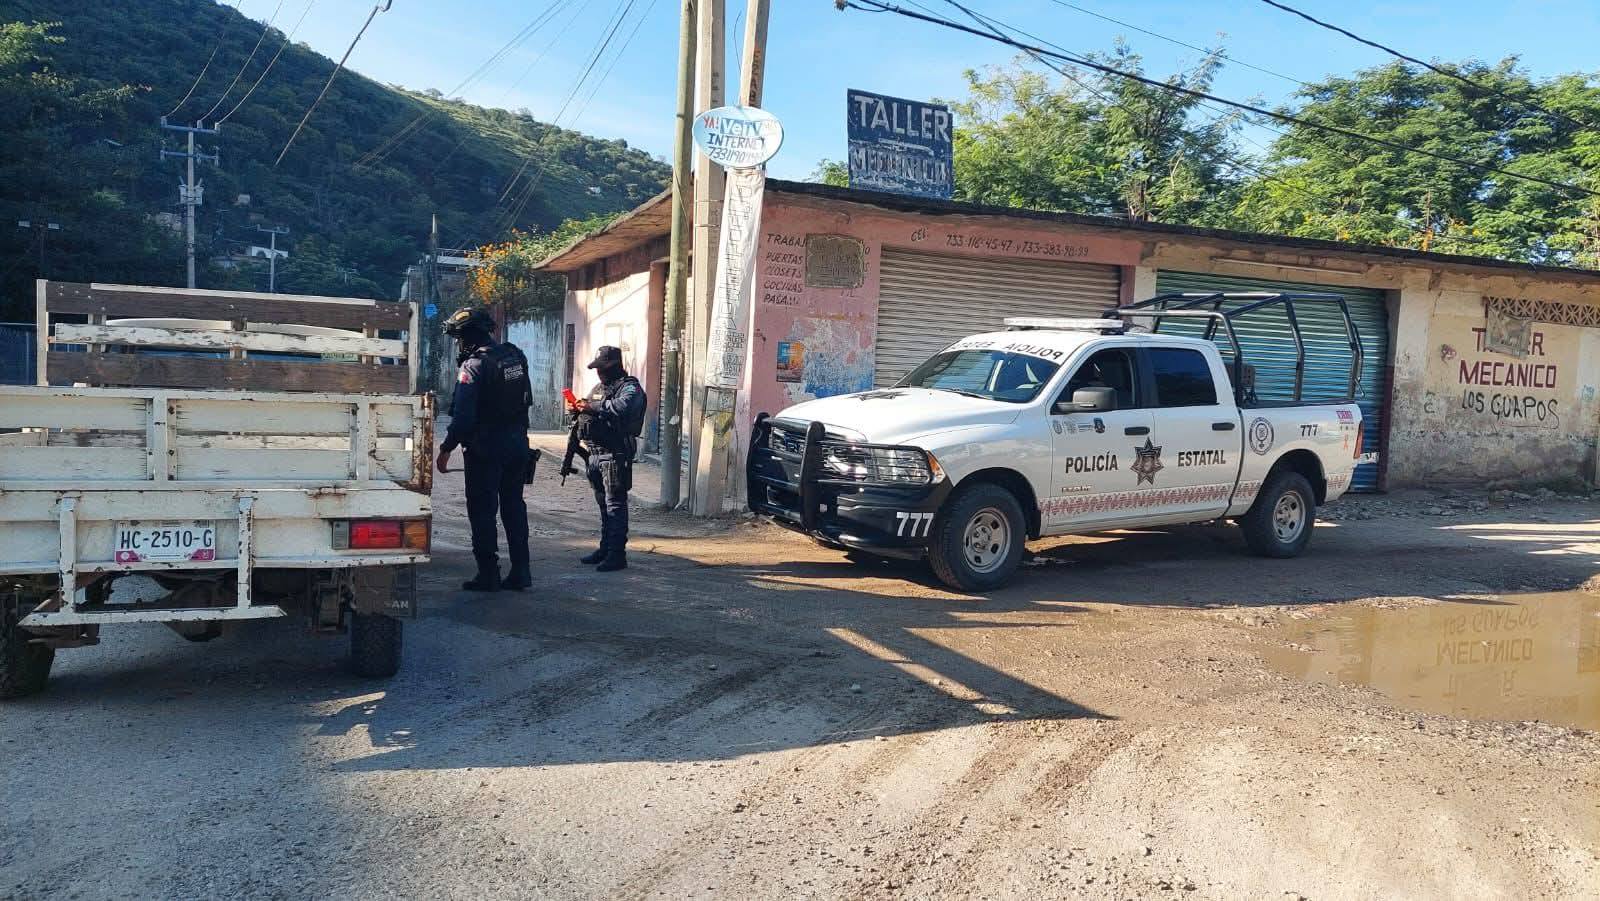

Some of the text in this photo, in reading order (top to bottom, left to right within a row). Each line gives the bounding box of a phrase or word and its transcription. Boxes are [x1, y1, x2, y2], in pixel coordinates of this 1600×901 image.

[854, 94, 951, 143] TALLER
[707, 132, 766, 150] INTERNET
[767, 233, 807, 248] TRABAJ
[766, 251, 803, 265] PUERTAS
[1459, 360, 1557, 388] MECANICO
[1462, 389, 1484, 413] LOS
[1490, 392, 1559, 429] GUAPOS
[1300, 424, 1319, 437] 777
[1065, 450, 1226, 473] POLICÍA ESTATAL
[896, 512, 934, 537] 777
[120, 529, 213, 549] HC-2510-G
